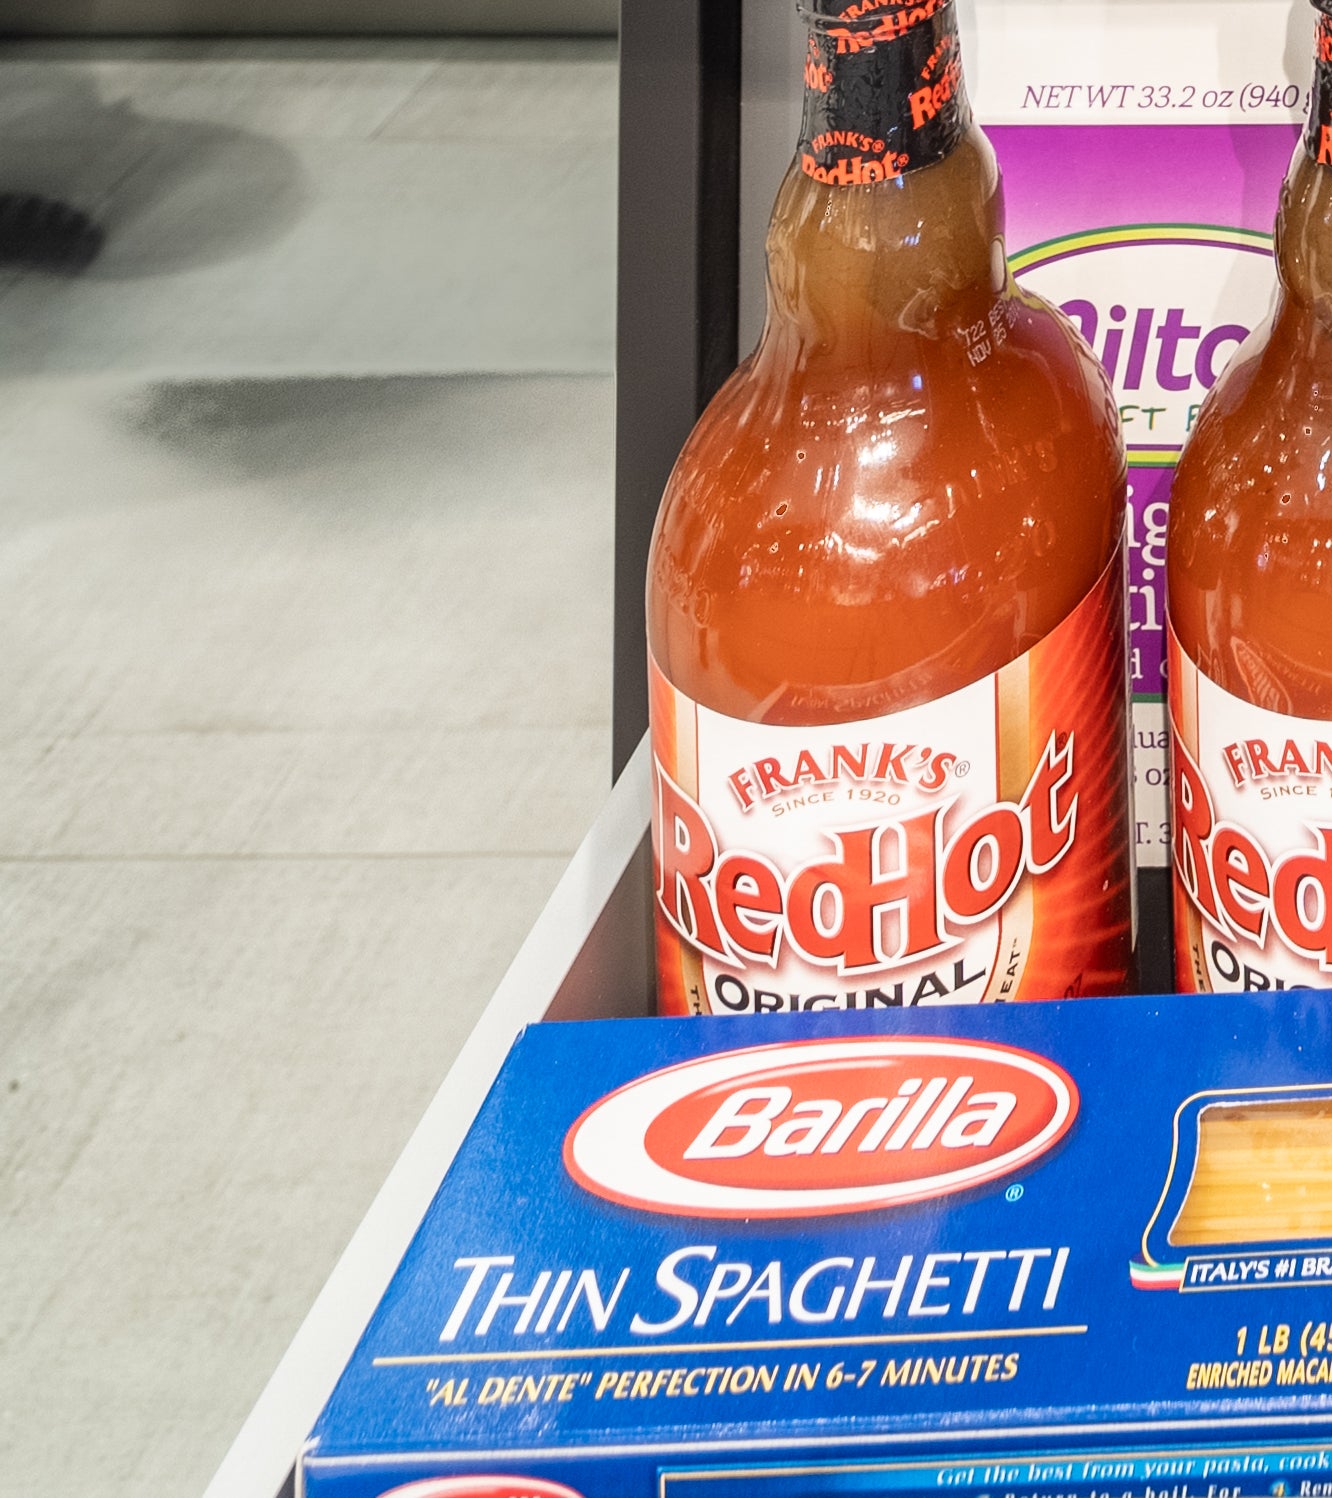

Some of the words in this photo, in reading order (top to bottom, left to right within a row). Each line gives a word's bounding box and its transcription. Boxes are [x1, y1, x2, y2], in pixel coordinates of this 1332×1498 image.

[1021, 85, 1082, 109] NET
[1087, 85, 1134, 109] WT
[1137, 84, 1197, 109] 33.2
[1201, 88, 1235, 109] oz
[728, 740, 957, 811] FRANK'S
[771, 791, 835, 818] SINCE
[846, 788, 901, 806] 1920
[1260, 784, 1317, 801] SINCE
[655, 728, 1080, 977] RedHot
[683, 1075, 1018, 1160] Barilla
[1190, 1259, 1269, 1284] ITALY'S
[1275, 1257, 1296, 1278] #1
[437, 1256, 627, 1342] THIN
[629, 1244, 1071, 1339] SPAGHETTI
[1236, 1325, 1248, 1355] 1
[1257, 1323, 1291, 1355] LB
[425, 1377, 468, 1407] "AL
[479, 1372, 592, 1405] DENTE"
[596, 1362, 778, 1401] PERFECTION
[784, 1361, 820, 1392] IN
[825, 1358, 875, 1390] 6-7
[881, 1352, 1020, 1387] MINUTES
[1186, 1359, 1273, 1391] ENRICHED
[936, 1467, 975, 1487] Get
[983, 1464, 1020, 1483] the
[1027, 1463, 1073, 1482] best
[1081, 1460, 1134, 1479] from
[1140, 1460, 1196, 1481] your
[1202, 1455, 1269, 1479] pasta,
